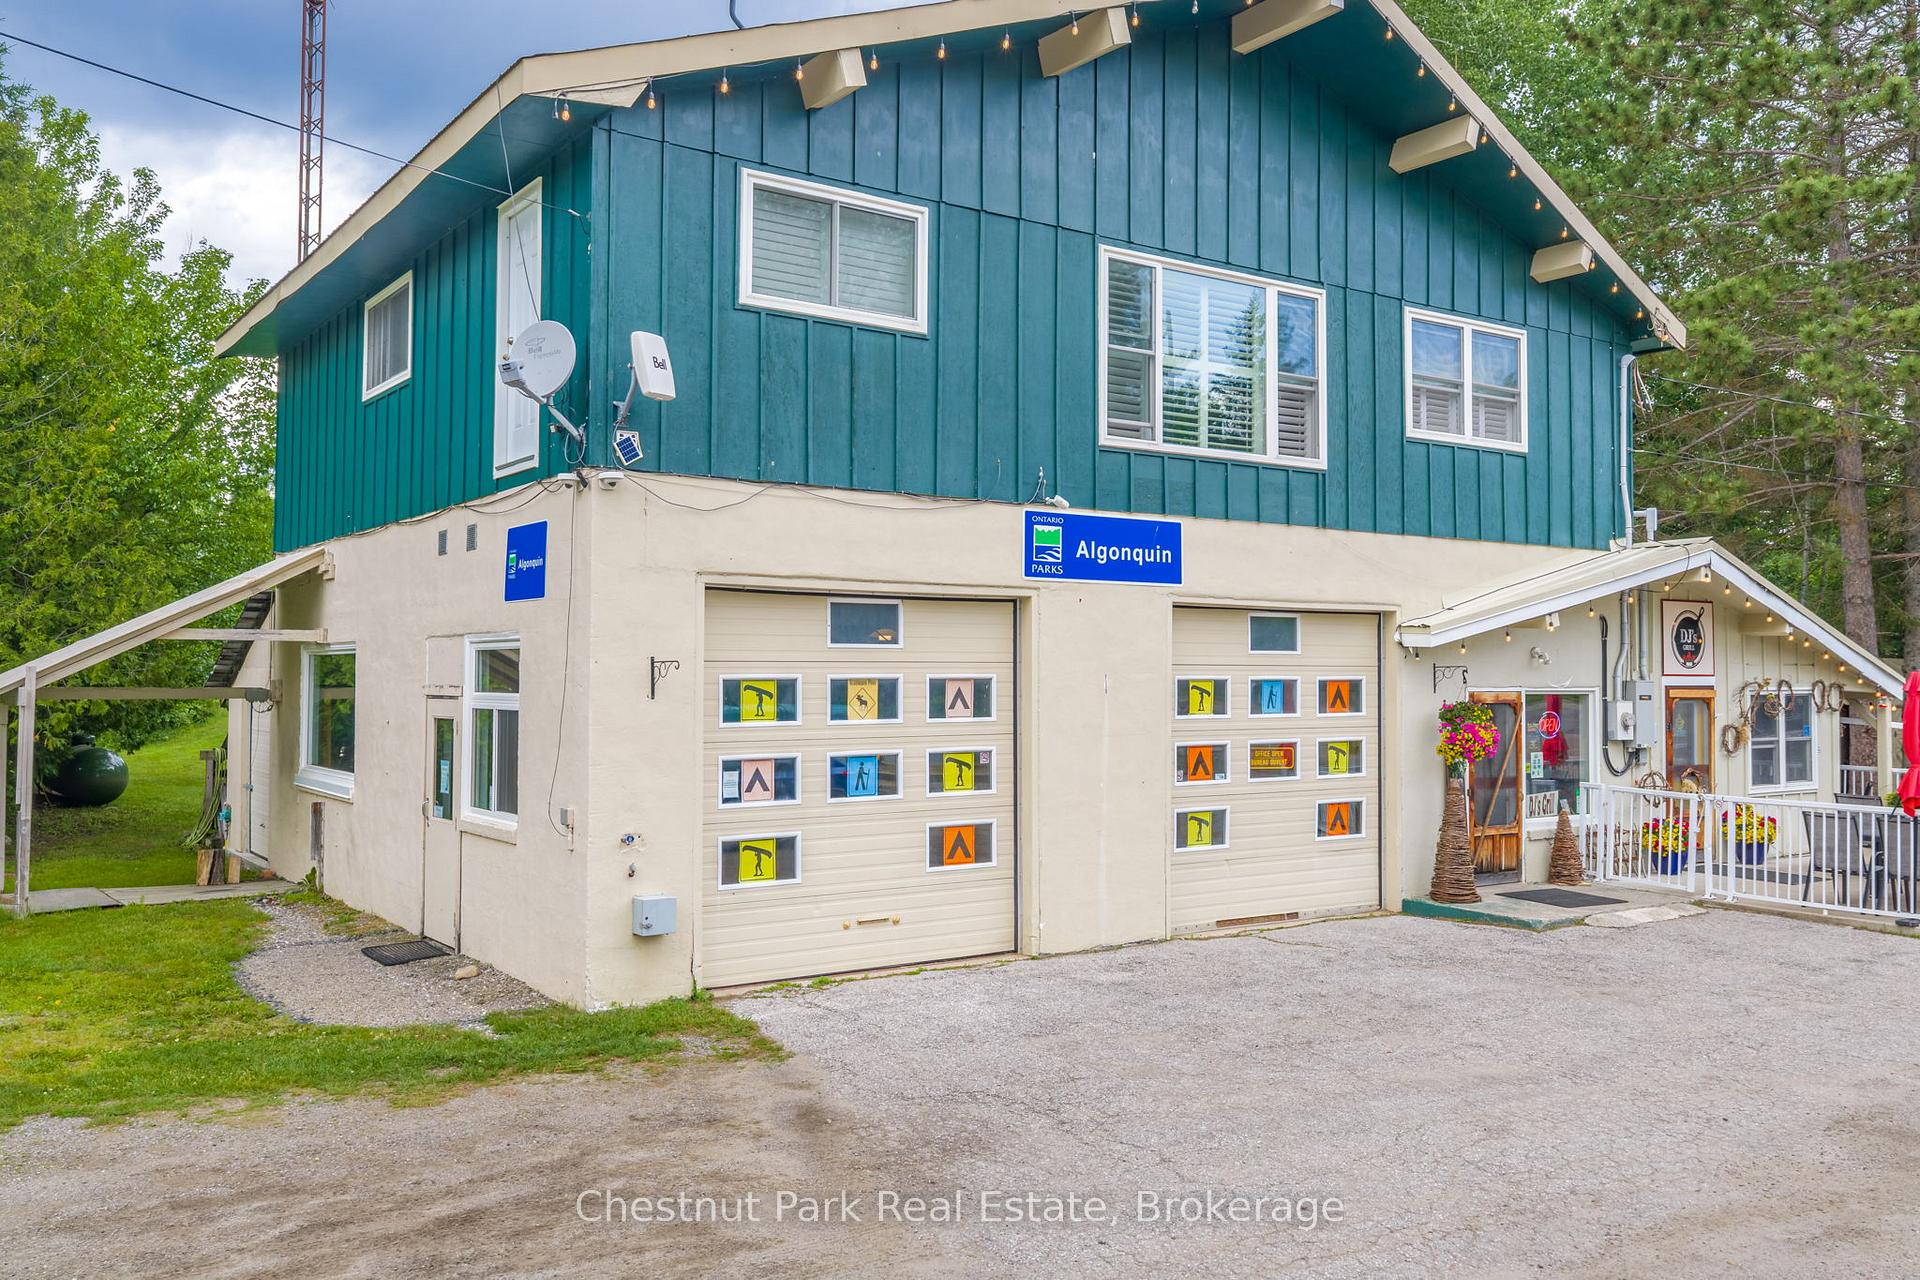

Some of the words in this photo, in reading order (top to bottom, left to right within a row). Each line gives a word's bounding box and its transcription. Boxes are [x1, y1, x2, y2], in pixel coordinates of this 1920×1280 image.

[653, 356, 667, 371] Bell
[1031, 515, 1064, 524] ONTARIO
[1075, 540, 1173, 566] Algonquin
[518, 556, 544, 571] Algonquin
[1031, 564, 1064, 575] PARKS
[1680, 629, 1698, 643] DJ's
[1539, 718, 1559, 732] OPEN
